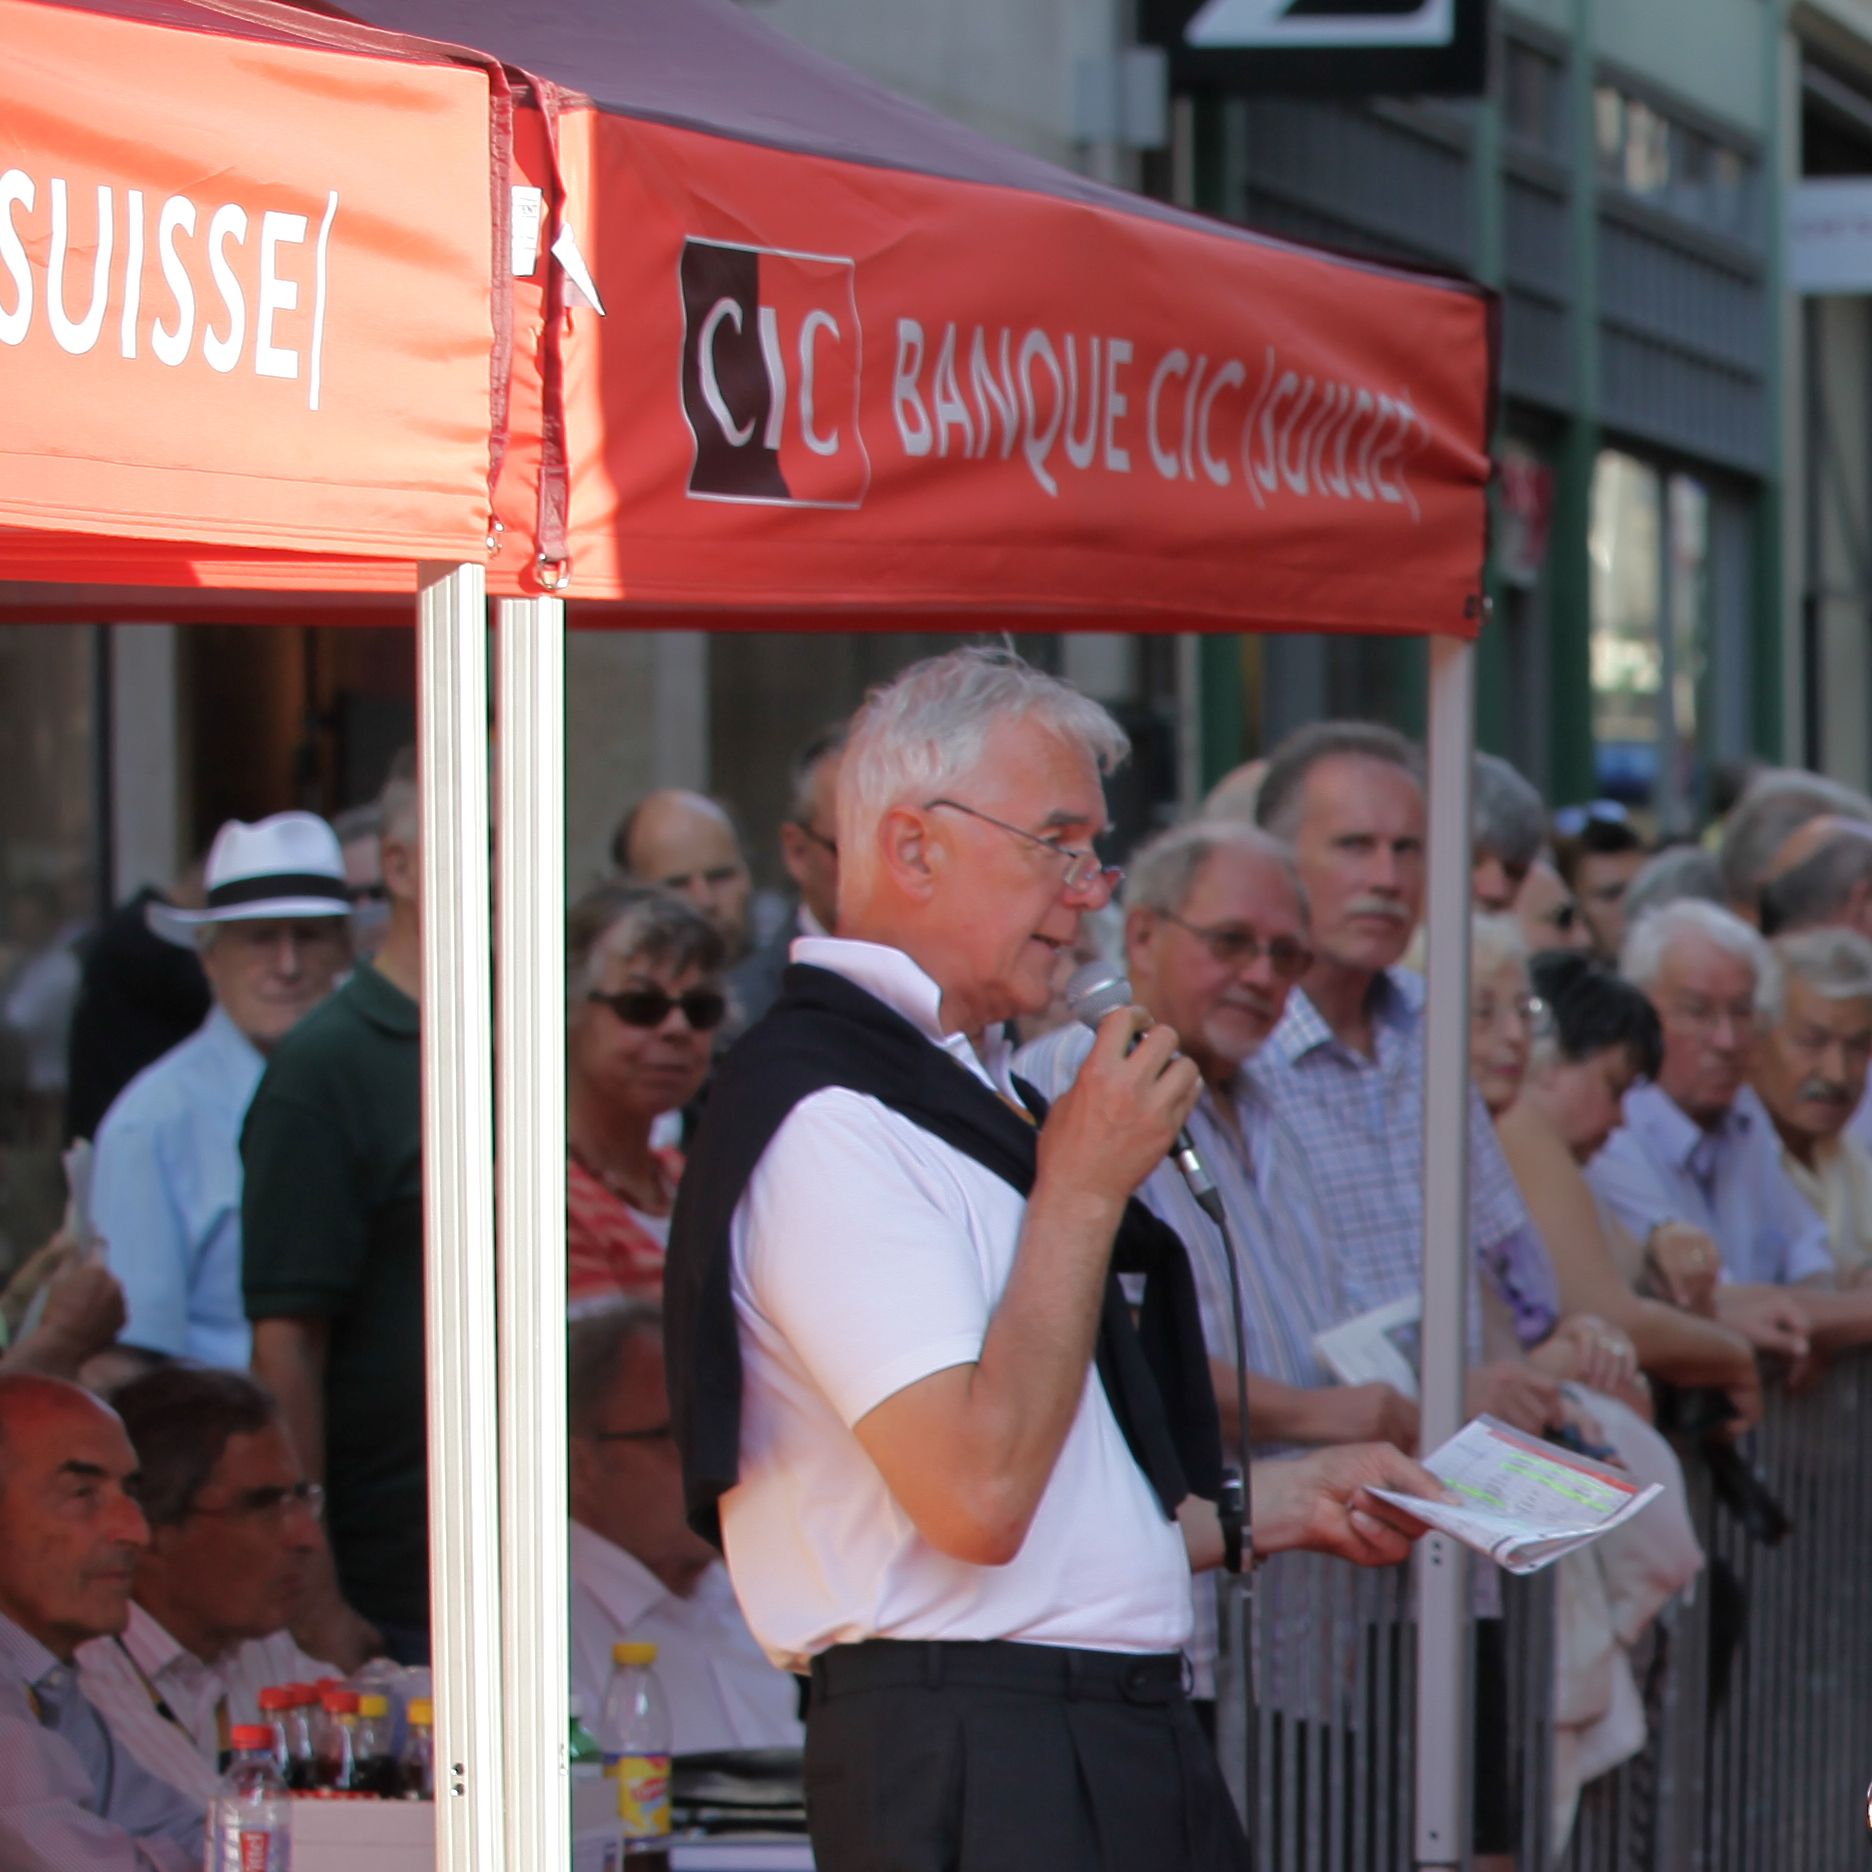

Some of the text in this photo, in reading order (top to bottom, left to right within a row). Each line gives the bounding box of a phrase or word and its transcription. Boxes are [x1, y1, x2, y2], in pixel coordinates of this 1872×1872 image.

[699, 298, 840, 456] CIC
[892, 317, 1133, 497] BANQUE
[1147, 348, 1245, 487] CIC
